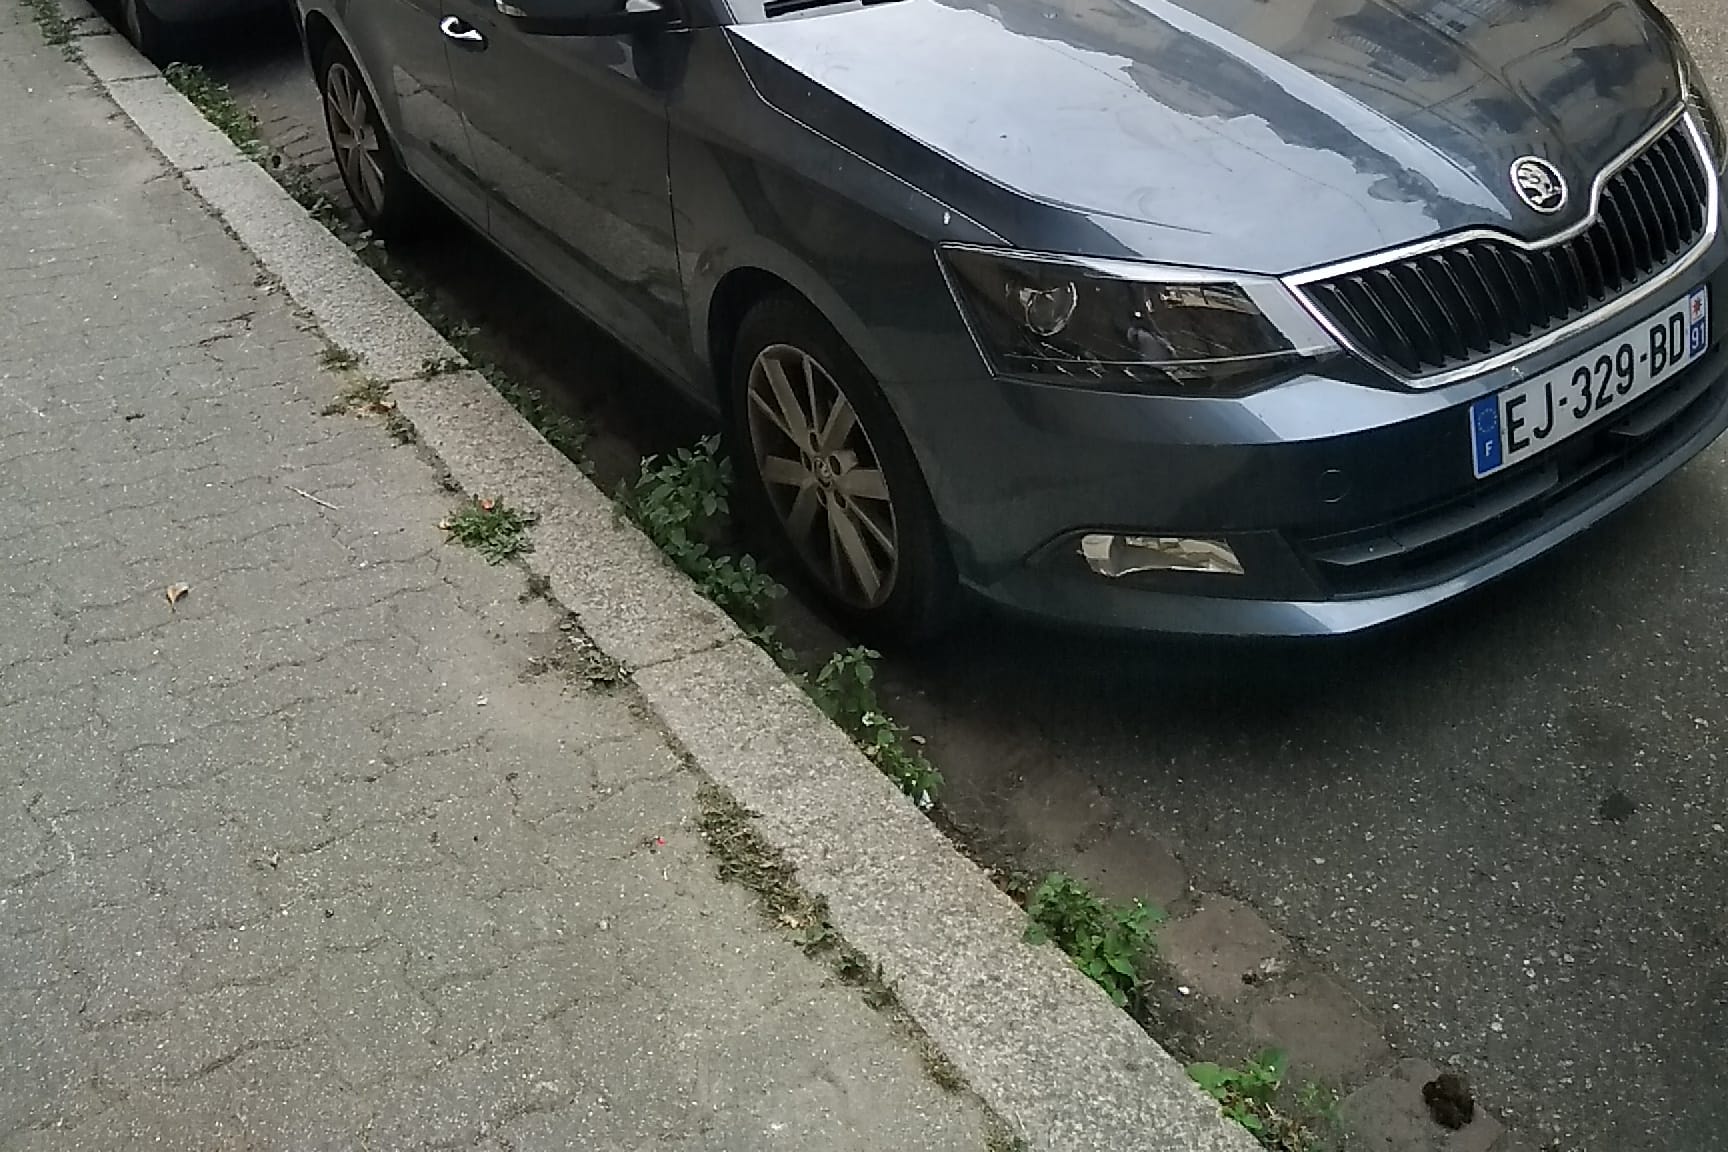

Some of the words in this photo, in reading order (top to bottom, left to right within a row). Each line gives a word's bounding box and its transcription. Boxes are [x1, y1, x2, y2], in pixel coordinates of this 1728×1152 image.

[1691, 322, 1706, 350] 91
[1504, 311, 1685, 454] EJ-329-BD
[1485, 441, 1493, 457] F
